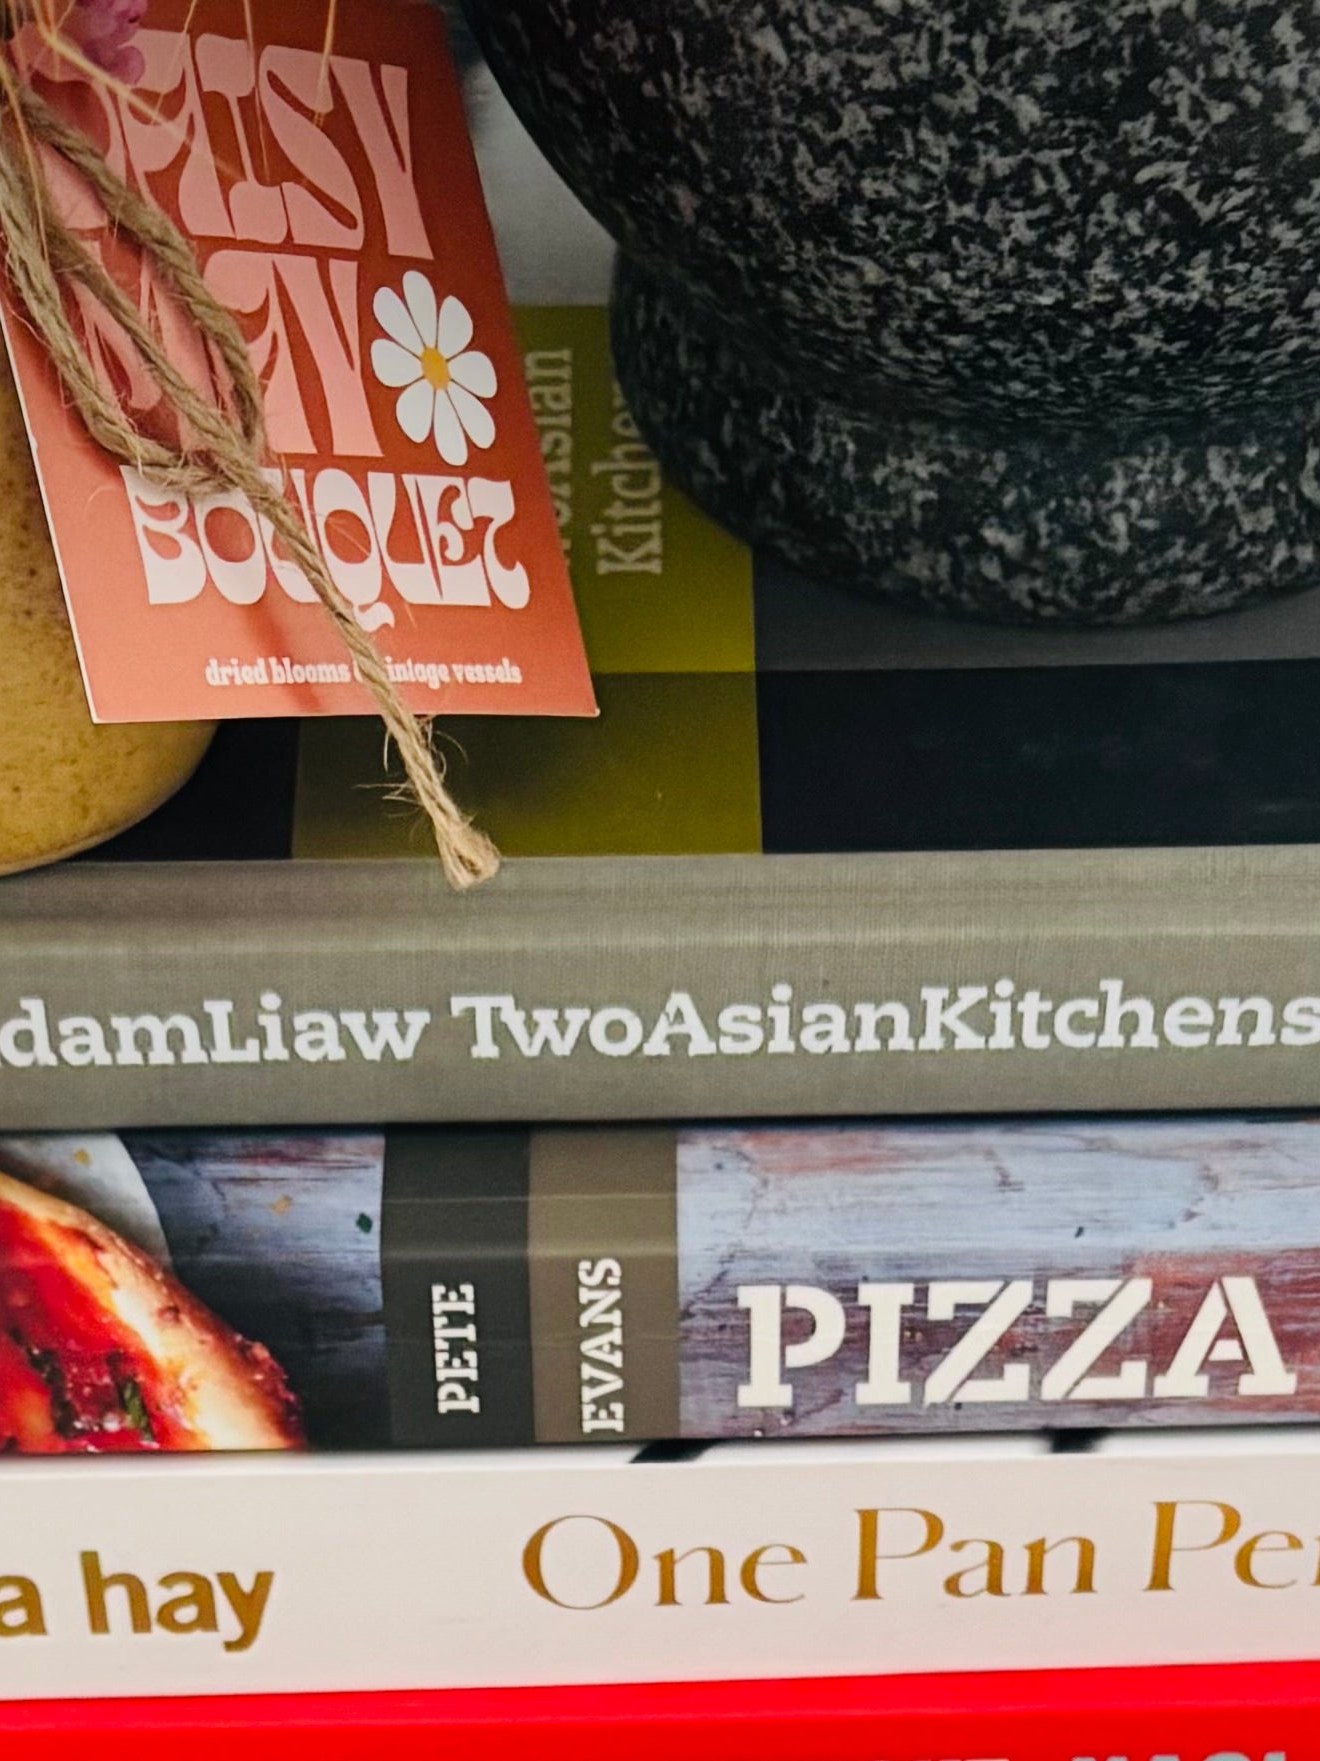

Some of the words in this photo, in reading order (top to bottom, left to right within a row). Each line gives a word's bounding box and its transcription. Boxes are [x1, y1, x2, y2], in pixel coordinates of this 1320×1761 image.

[119, 465, 530, 632] BOUQUET
[205, 657, 269, 686] dried
[270, 656, 352, 685] blooms
[385, 655, 450, 690] intage
[452, 656, 523, 685] vessels
[431, 1283, 480, 1414] PETE
[578, 1257, 625, 1433] EVANS
[737, 1276, 1298, 1408] PIZZA
[78, 1550, 275, 1652] hay
[522, 1514, 808, 1609] One
[851, 1507, 1098, 1601] Pan
